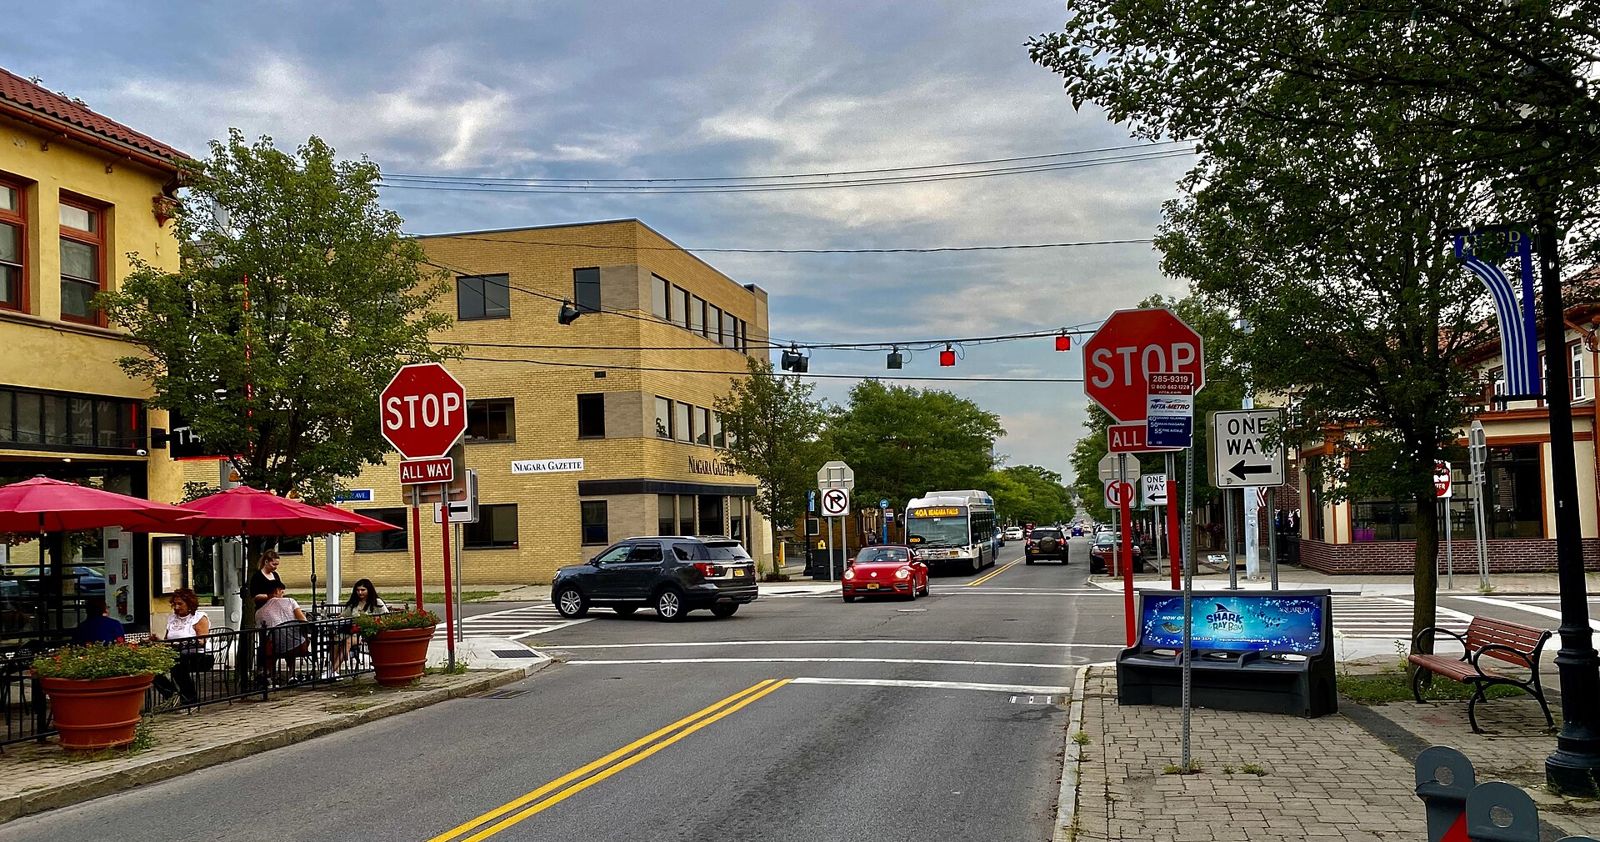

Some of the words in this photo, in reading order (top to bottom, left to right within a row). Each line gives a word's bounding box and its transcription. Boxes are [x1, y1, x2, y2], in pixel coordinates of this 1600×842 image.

[1091, 342, 1195, 389] STOP
[1153, 375, 1188, 383] 285-9319
[386, 392, 460, 430] STOP
[1227, 417, 1268, 435] ONE
[1112, 430, 1142, 448] ALL
[402, 465, 423, 480] ALL
[426, 463, 450, 477] WAY
[1146, 475, 1165, 483] ONE
[1206, 613, 1244, 624] SHARK
[1213, 622, 1227, 631] RAY
